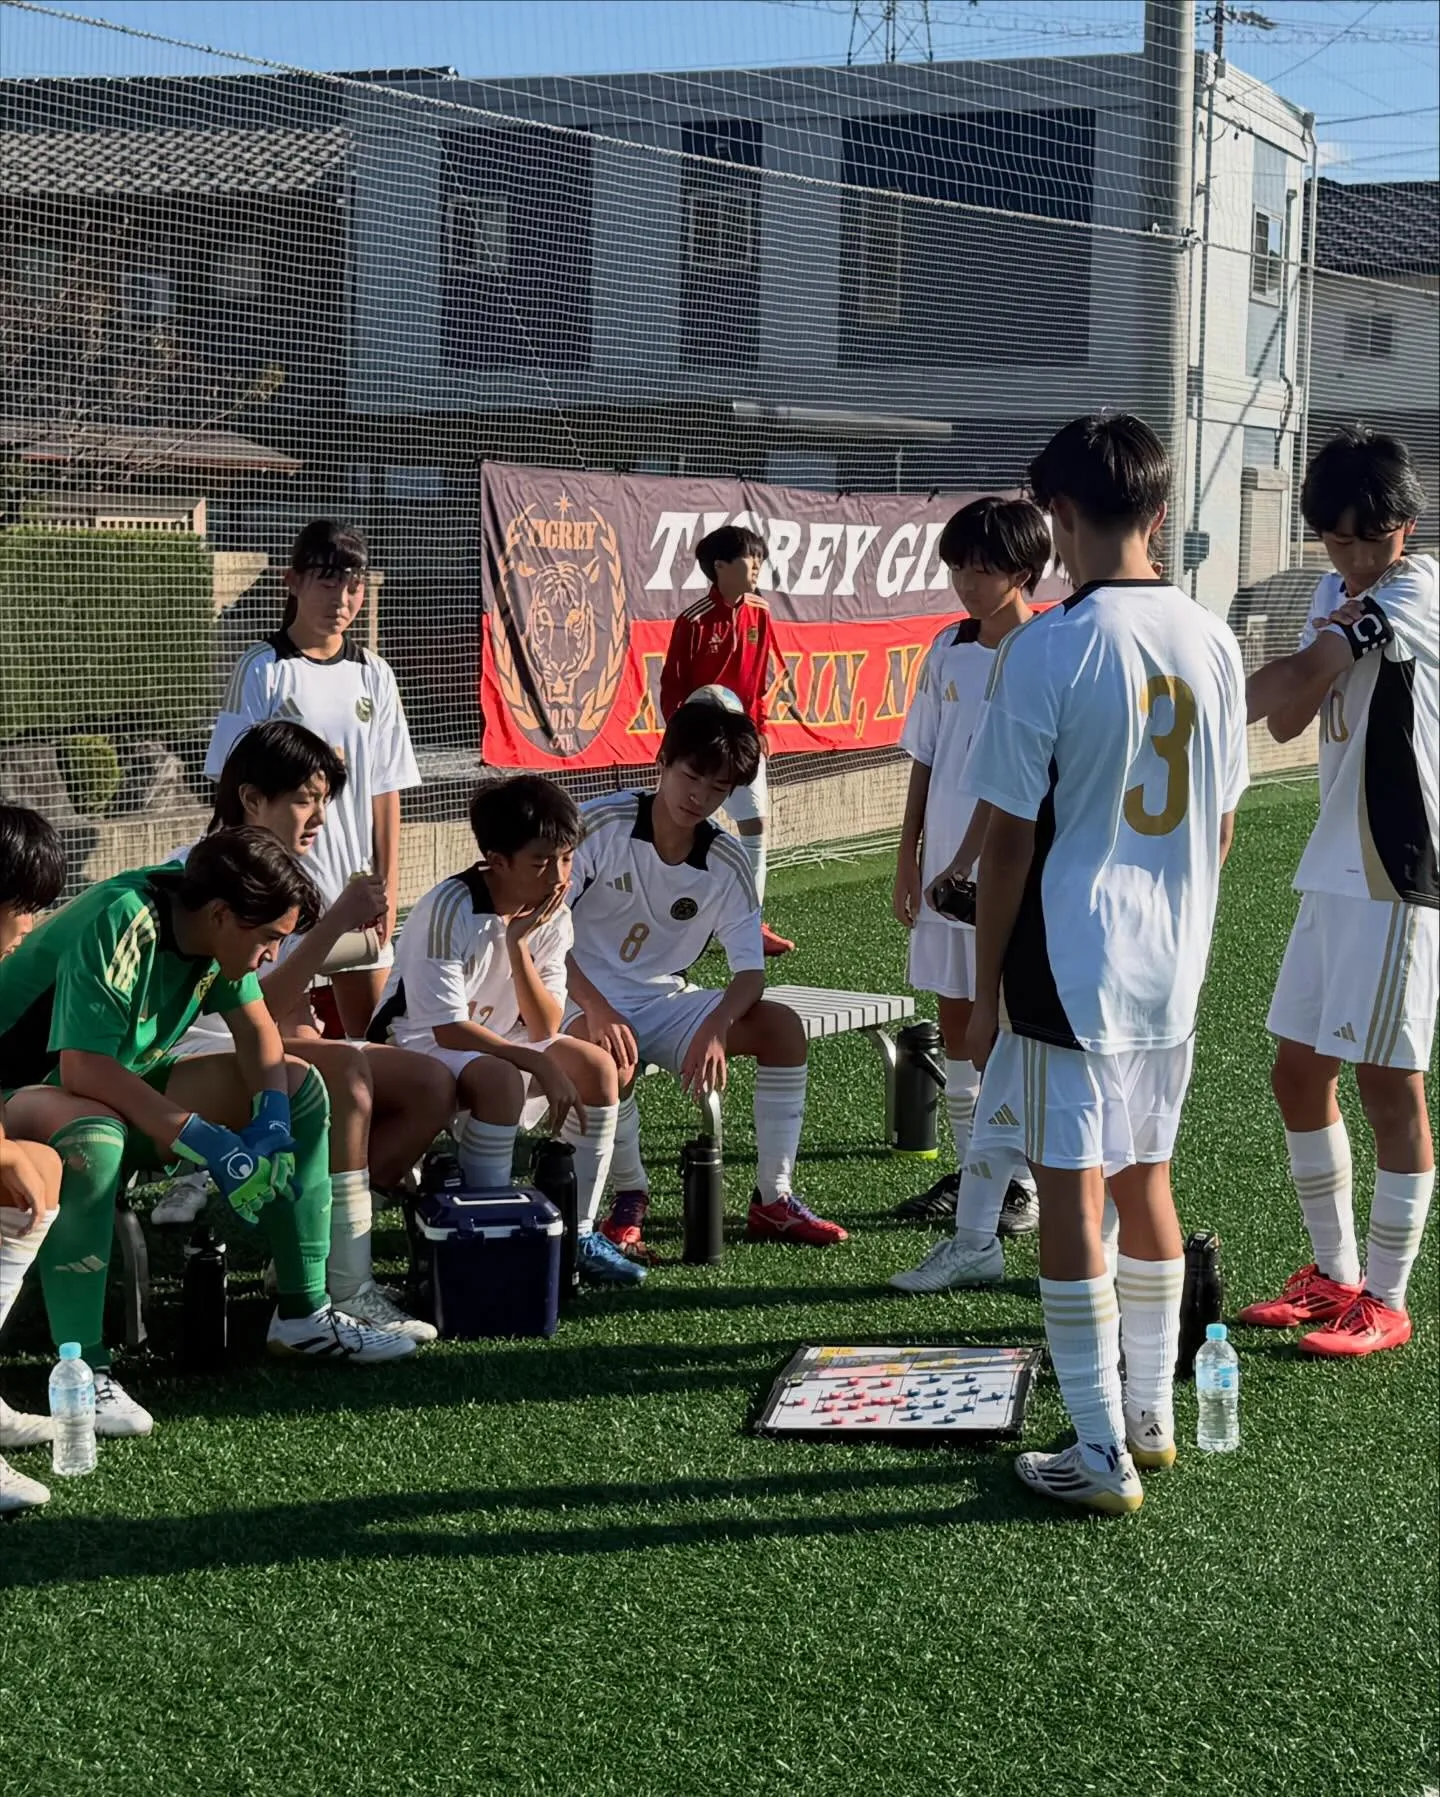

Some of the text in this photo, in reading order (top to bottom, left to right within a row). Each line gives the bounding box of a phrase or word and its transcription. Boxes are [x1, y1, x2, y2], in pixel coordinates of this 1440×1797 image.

[523, 518, 599, 550] TIGREY
[644, 509, 881, 597] TIREY
[1123, 674, 1197, 837] 3
[619, 921, 650, 963] 8
